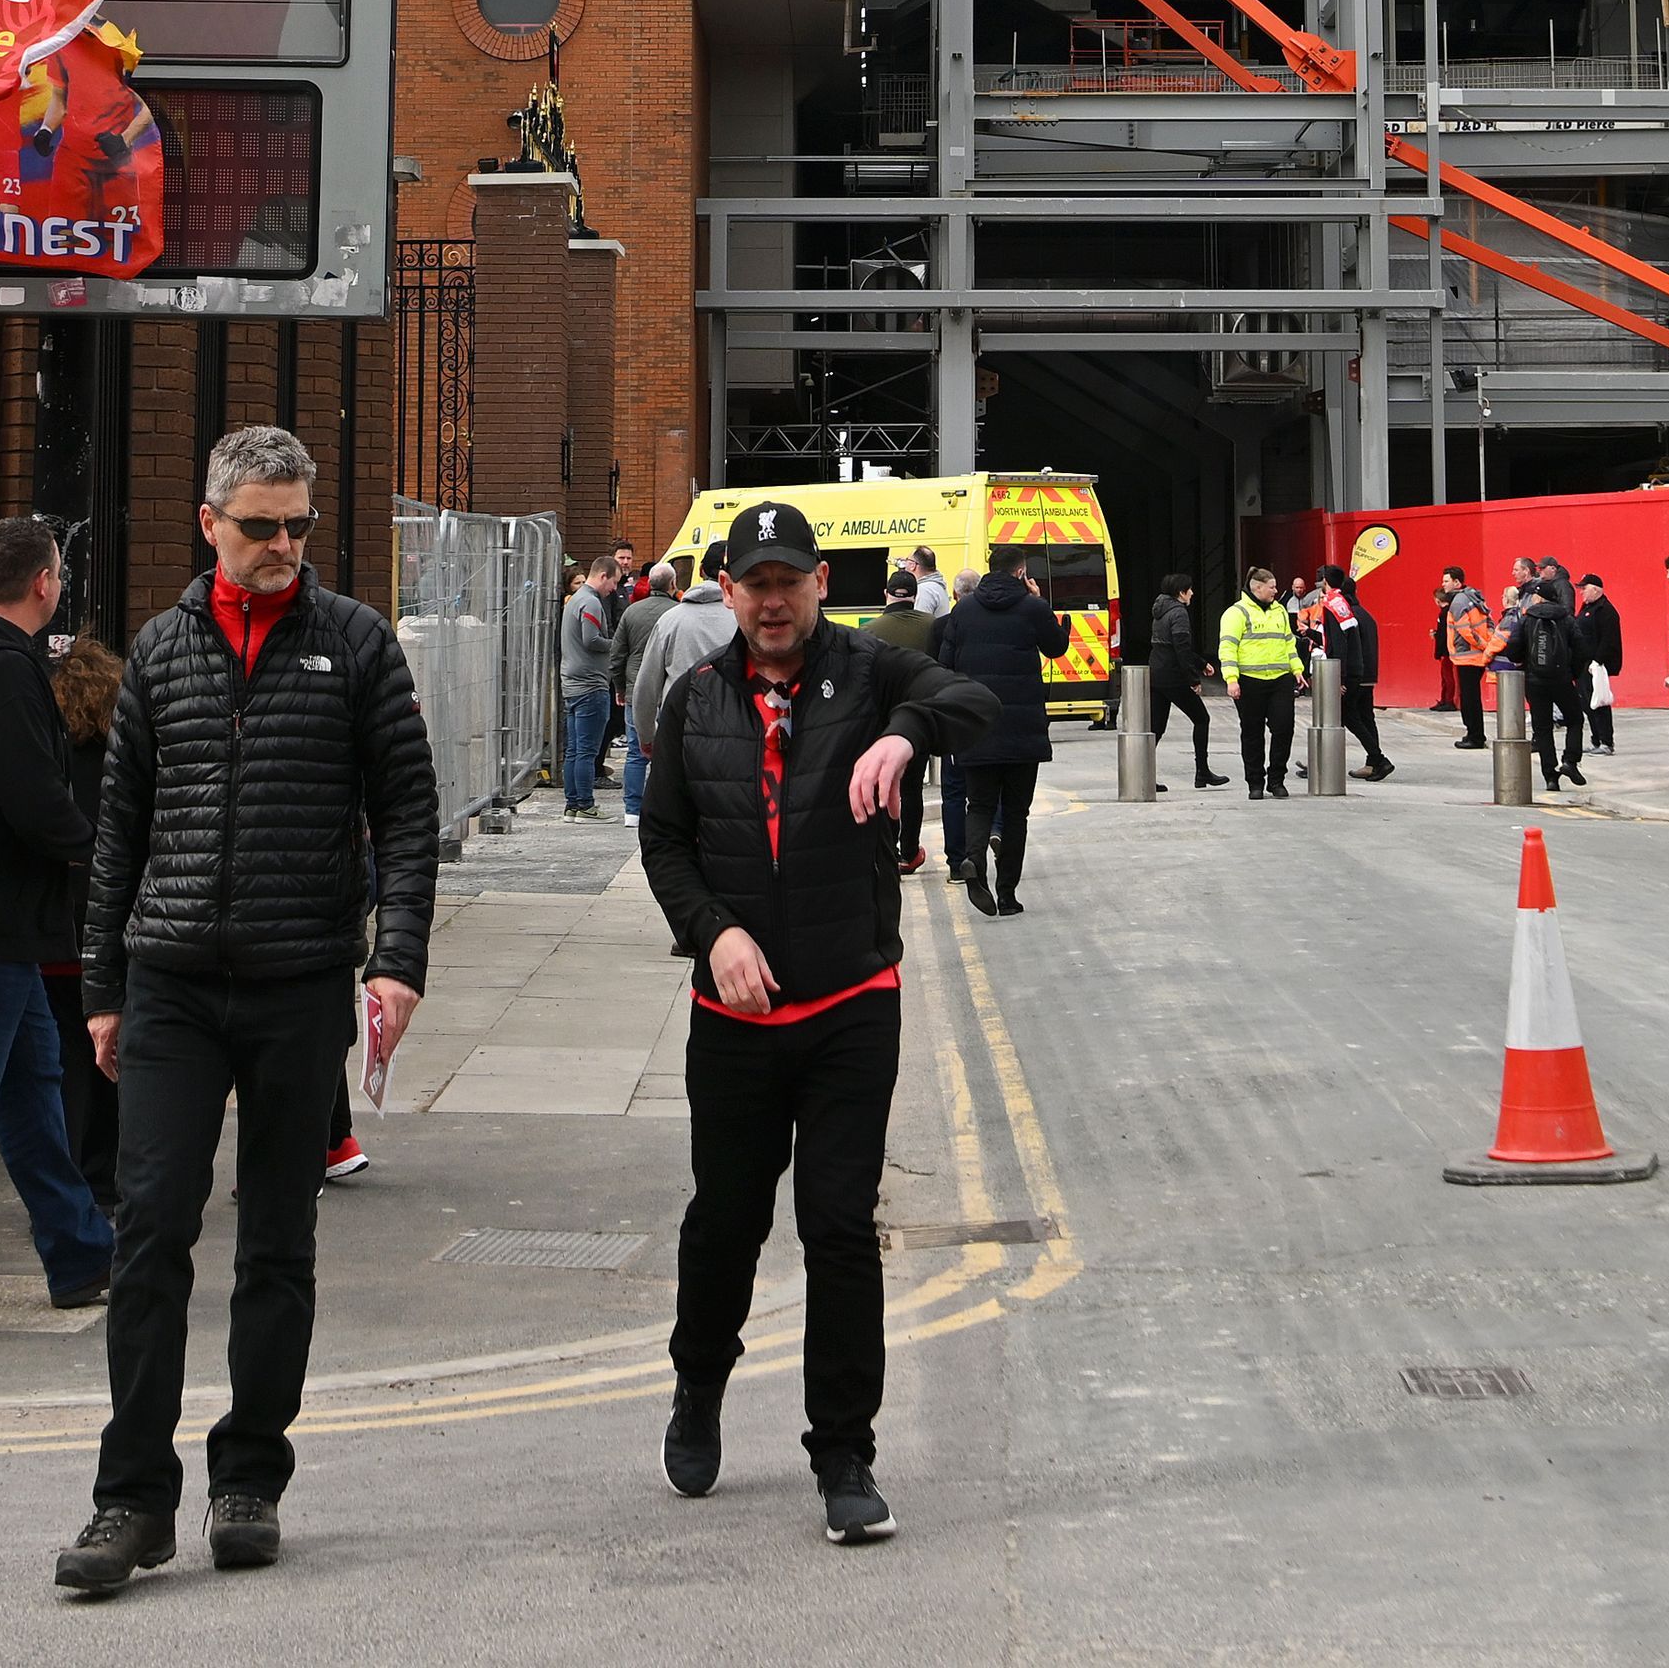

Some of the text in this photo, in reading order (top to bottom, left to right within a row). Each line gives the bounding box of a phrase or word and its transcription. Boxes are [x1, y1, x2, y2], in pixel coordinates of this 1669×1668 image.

[1454, 120, 1482, 132] J&D
[1, 177, 22, 197] 23
[994, 507, 1089, 517] NORTH WEST AMBULANCE
[840, 518, 927, 537] AMBULANCE
